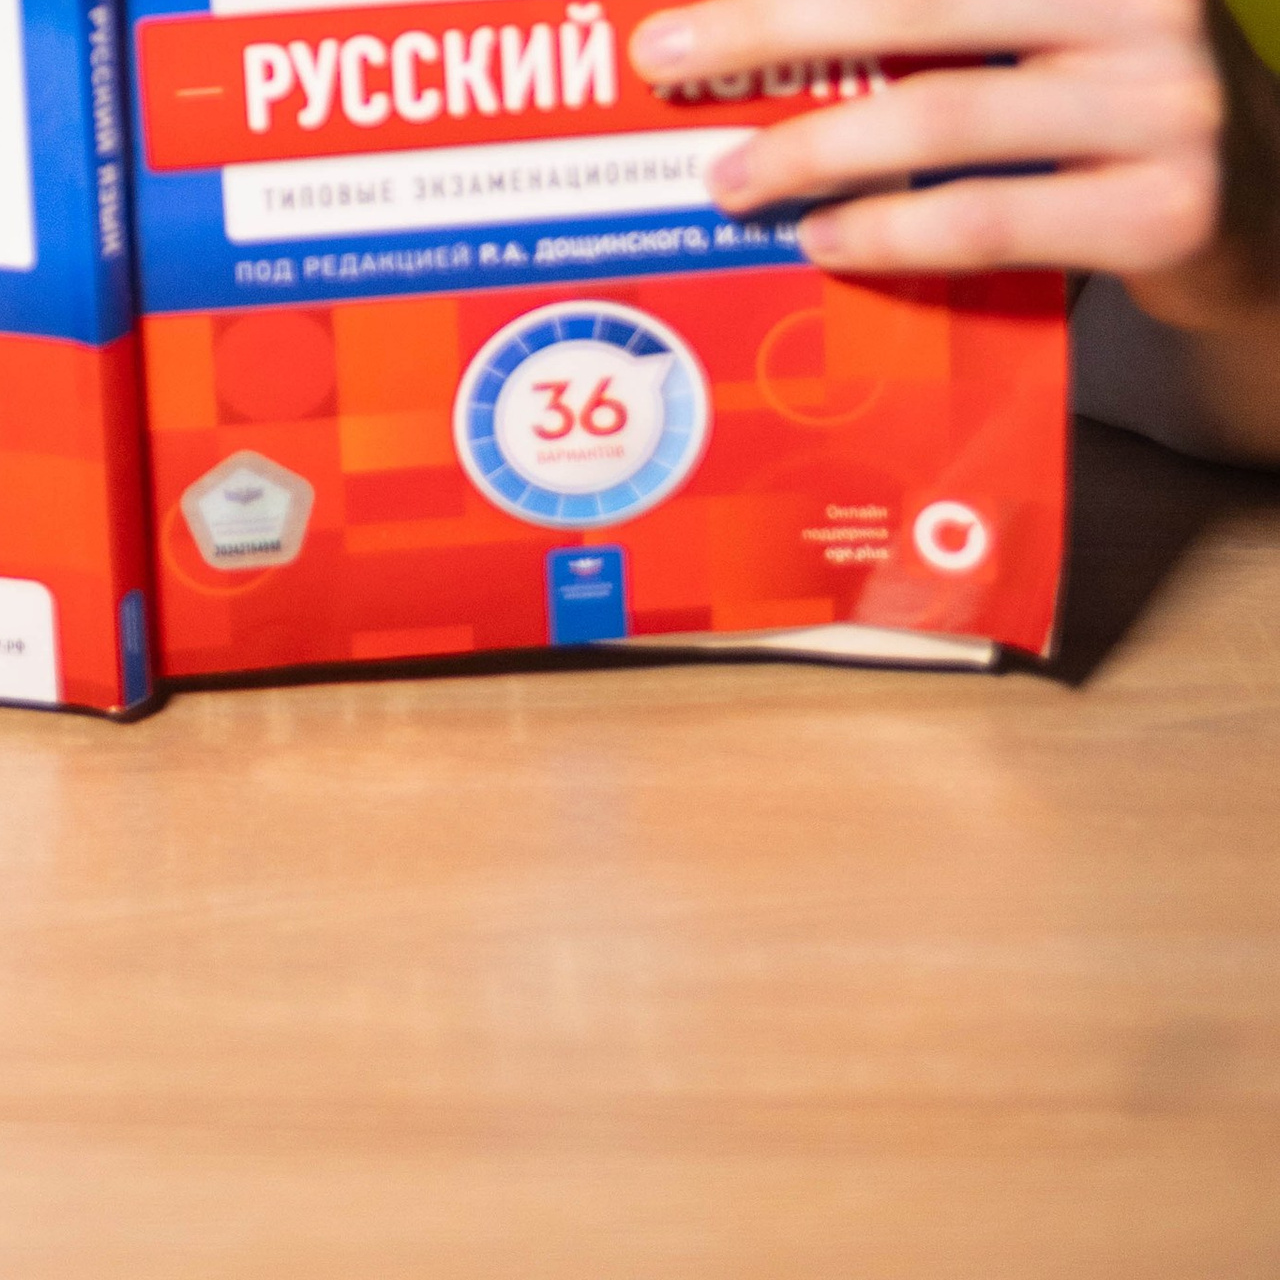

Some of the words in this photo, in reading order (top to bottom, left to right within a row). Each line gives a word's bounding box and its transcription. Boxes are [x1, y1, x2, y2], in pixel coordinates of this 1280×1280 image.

[242, 1, 619, 136] РУССКИЙ
[263, 176, 396, 214] ТИПОВЫЕ
[412, 154, 700, 203] ЭКЗАМЕНАЦИОННЫЕ
[235, 258, 294, 287] ПОД
[303, 242, 471, 284] РЕДАКЦИЕЙ
[529, 373, 630, 444] 36
